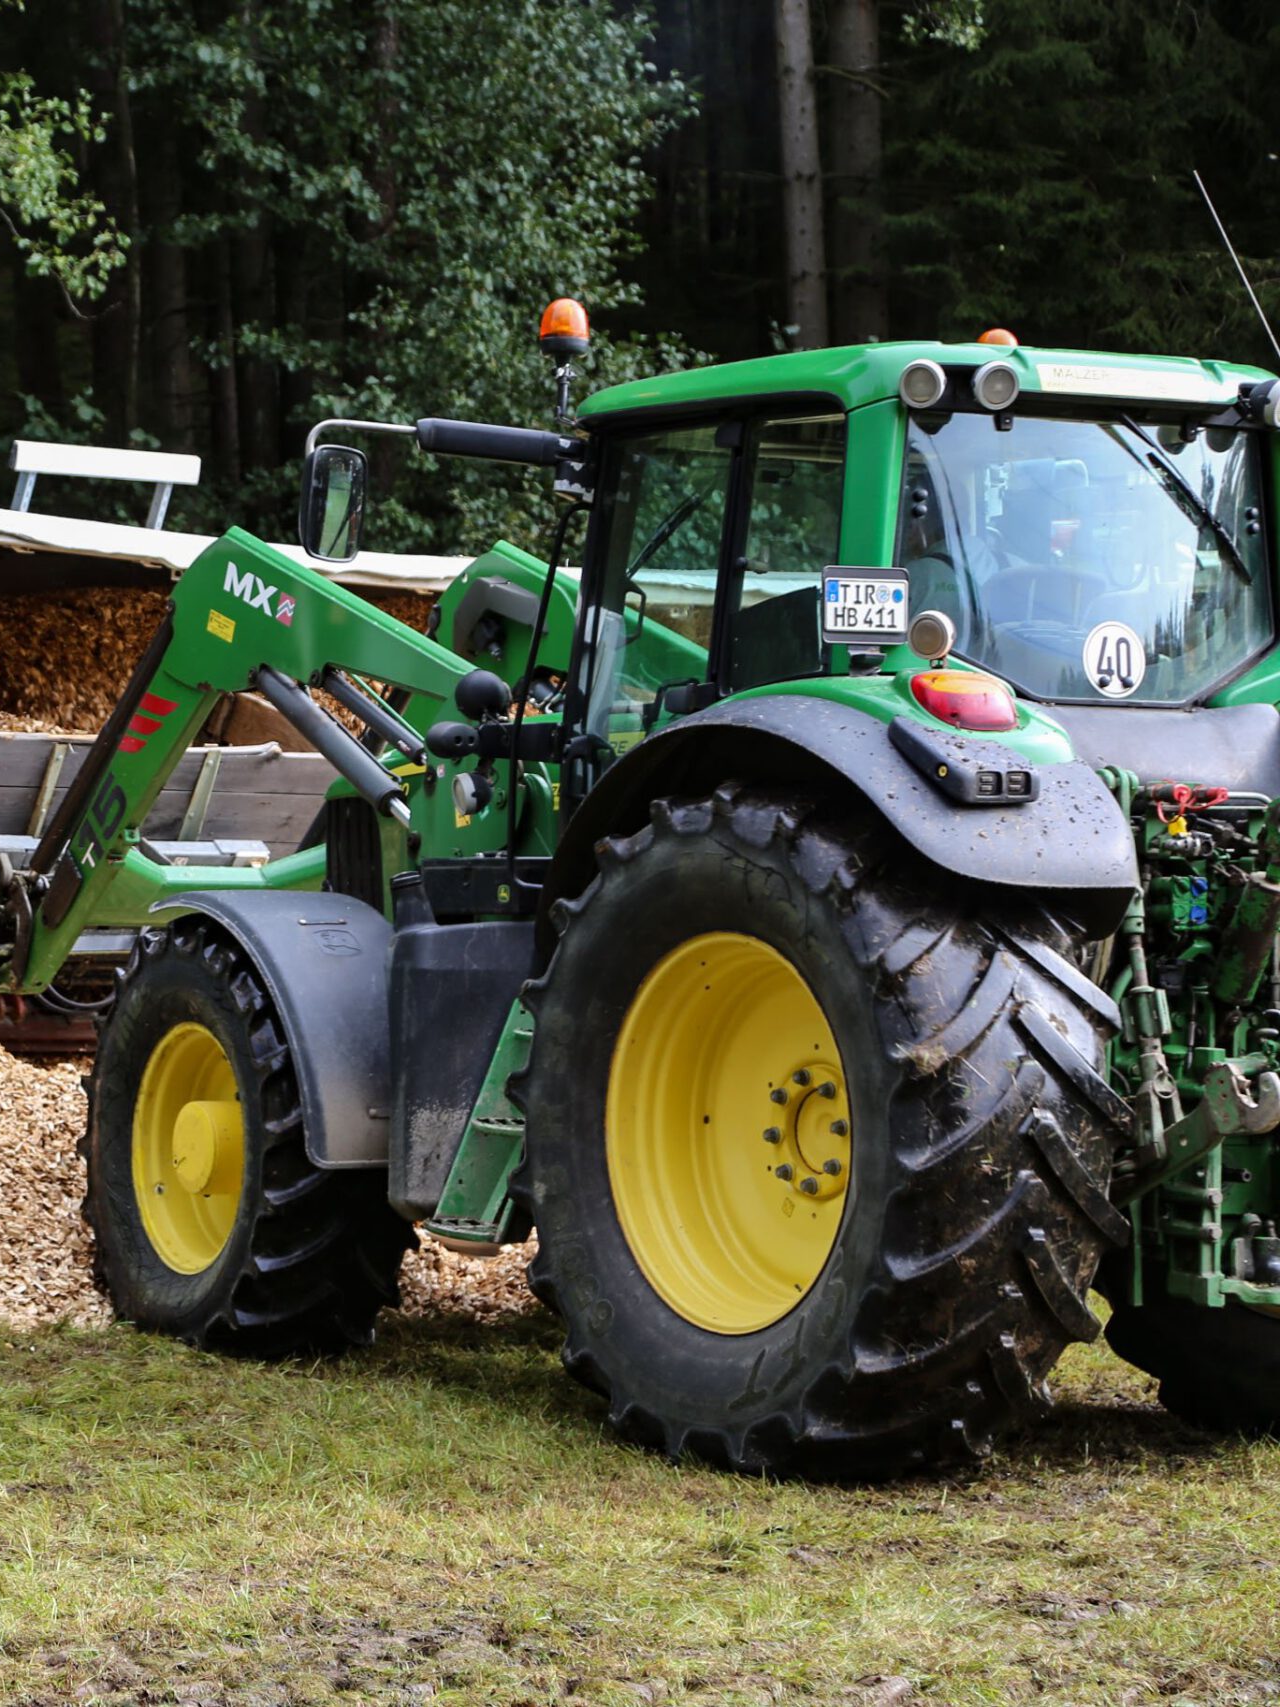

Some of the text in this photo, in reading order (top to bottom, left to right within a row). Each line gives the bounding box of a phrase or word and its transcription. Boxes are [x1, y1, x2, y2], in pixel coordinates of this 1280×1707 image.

[223, 561, 279, 617] MX
[840, 584, 876, 605] TIR
[834, 607, 897, 629] HB 411
[1096, 636, 1131, 682] 40
